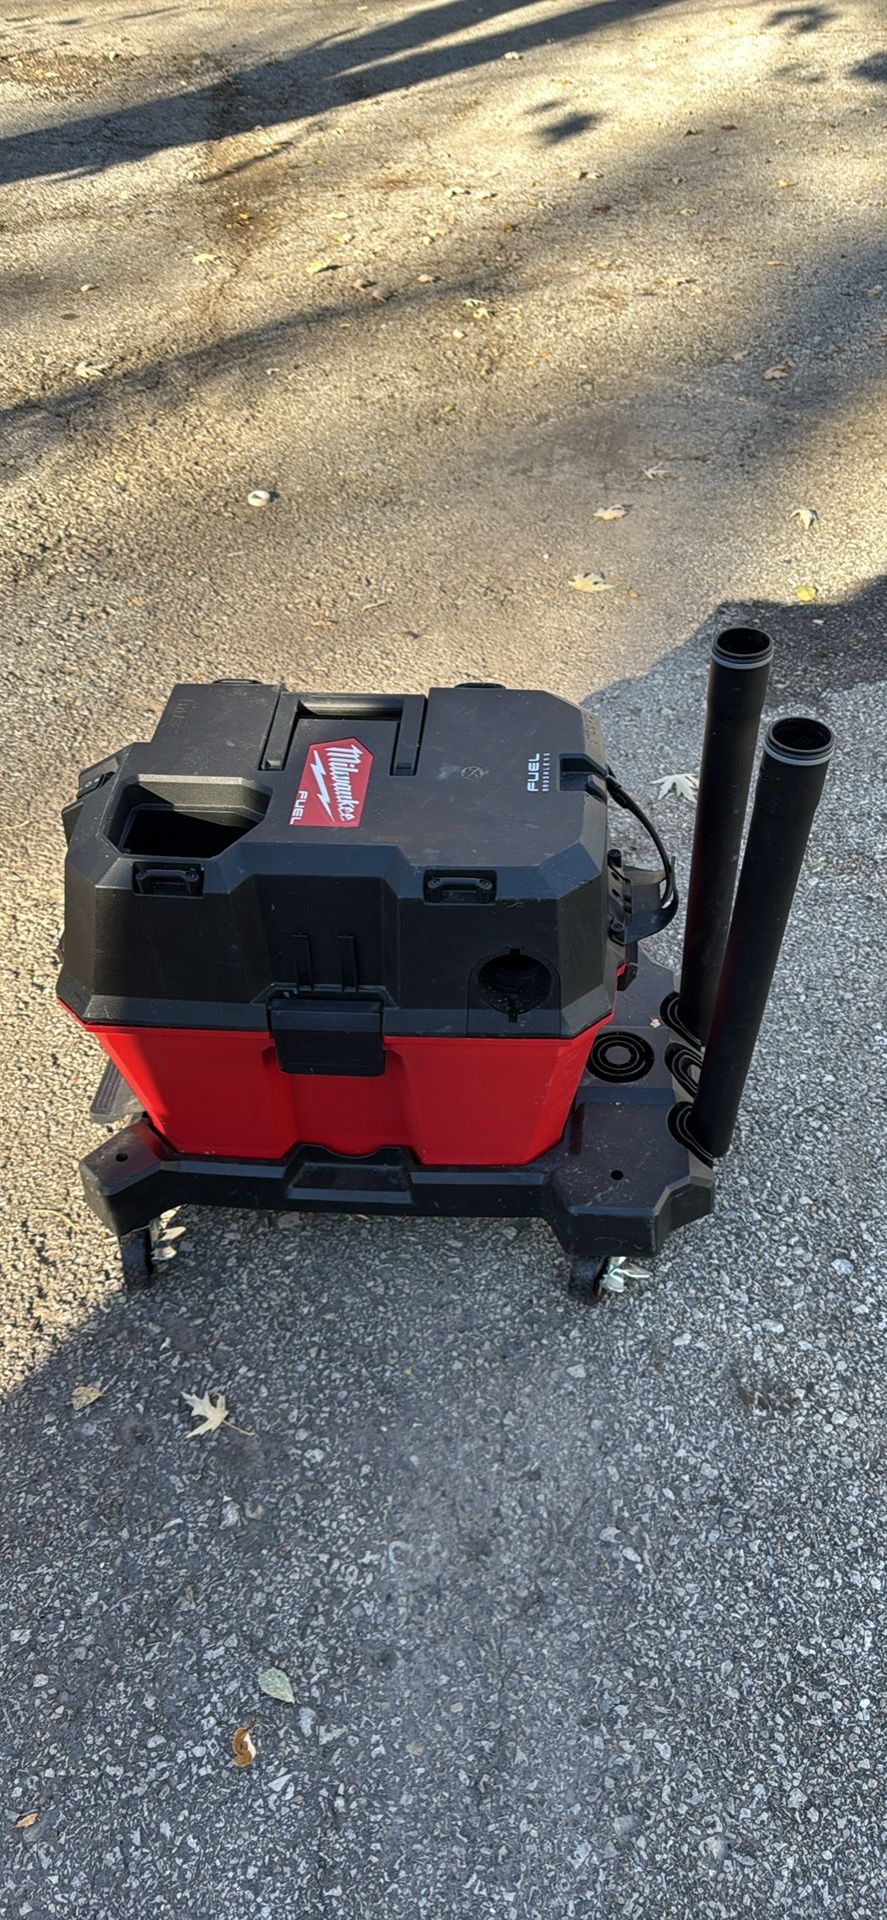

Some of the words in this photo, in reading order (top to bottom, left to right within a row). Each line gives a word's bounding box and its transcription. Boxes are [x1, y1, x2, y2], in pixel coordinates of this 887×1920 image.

[325, 744, 364, 822] Milwaukee
[527, 753, 540, 792] FUEL
[289, 791, 308, 825] FUEL
